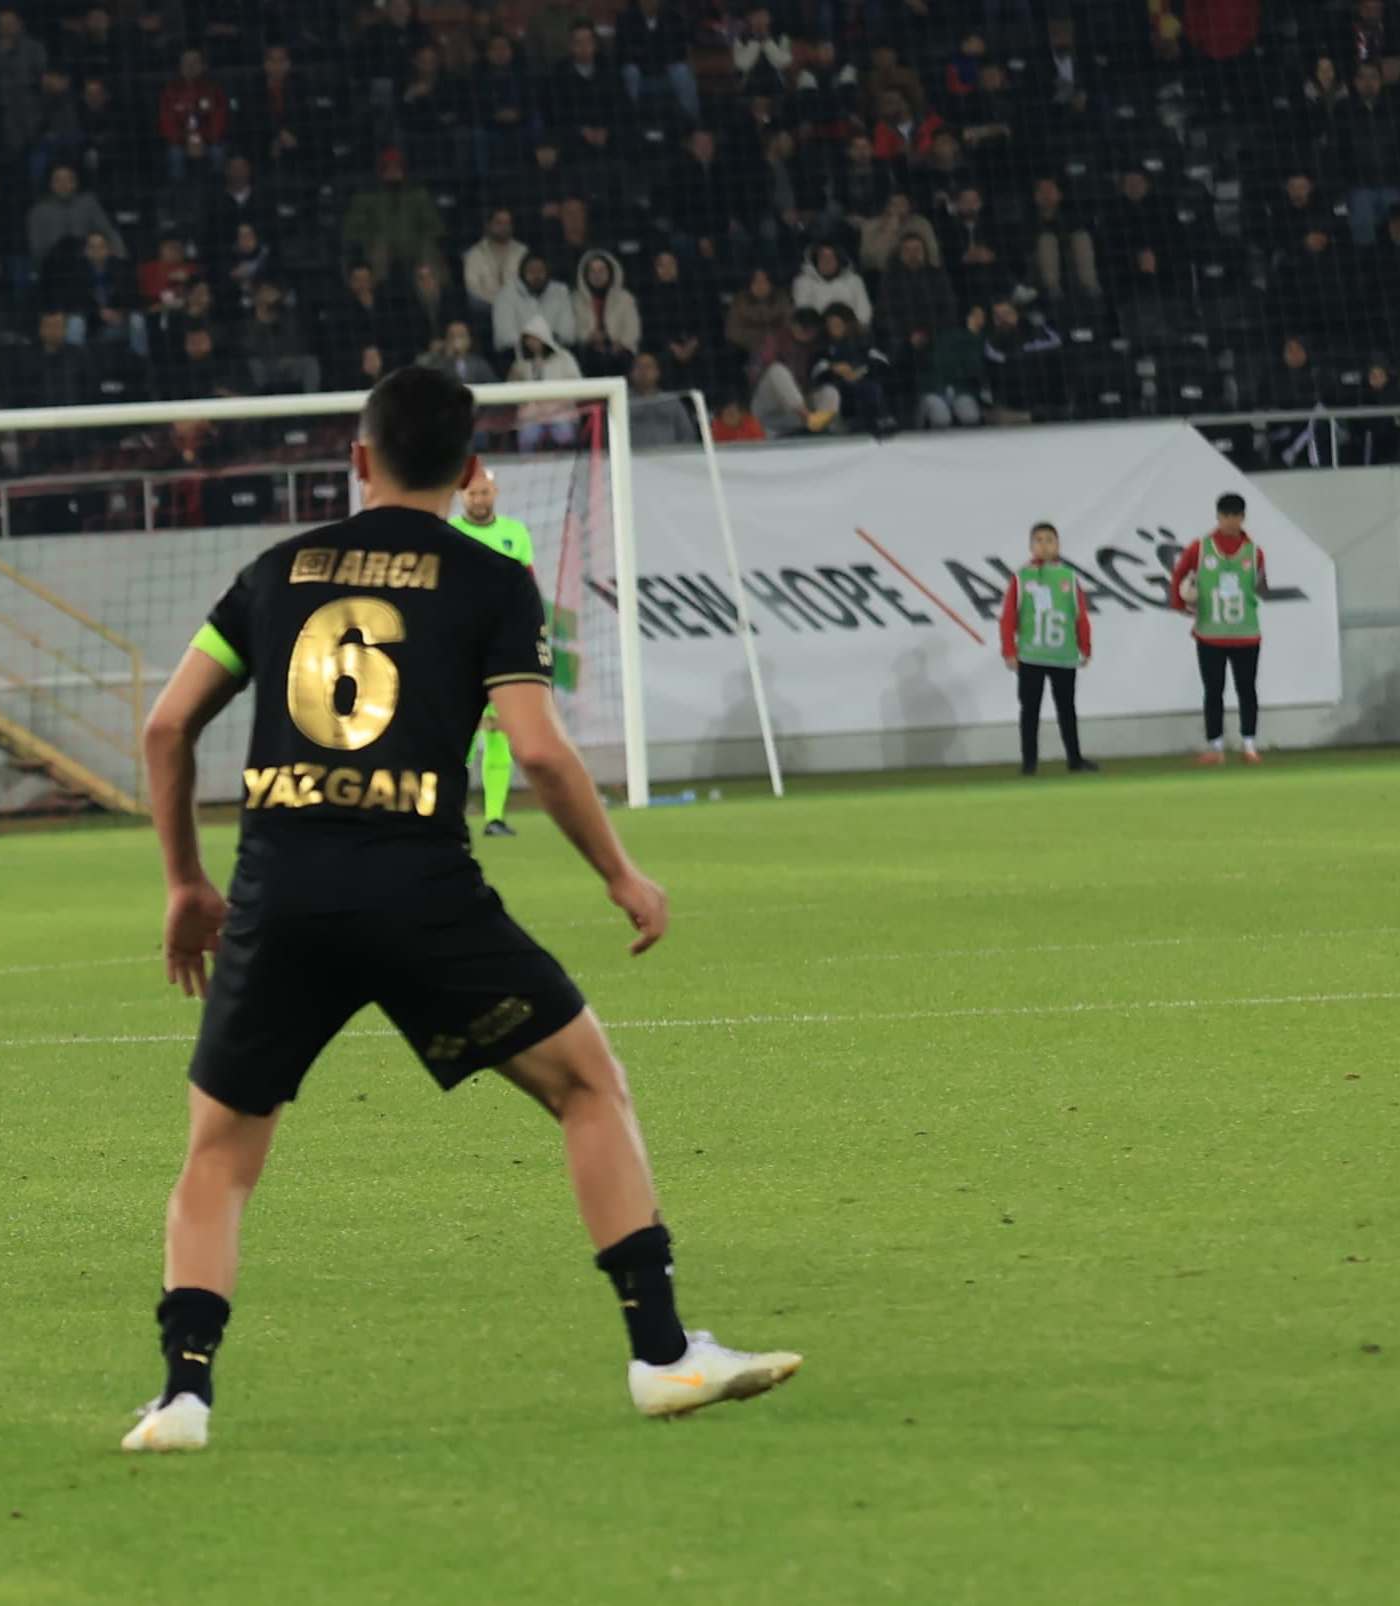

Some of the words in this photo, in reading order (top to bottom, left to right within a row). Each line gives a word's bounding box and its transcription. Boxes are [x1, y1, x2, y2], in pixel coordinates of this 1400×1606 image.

[333, 550, 439, 590] ARCA
[741, 563, 932, 632] HOPE
[287, 595, 406, 751] 6
[243, 762, 437, 816] YAZGAN
